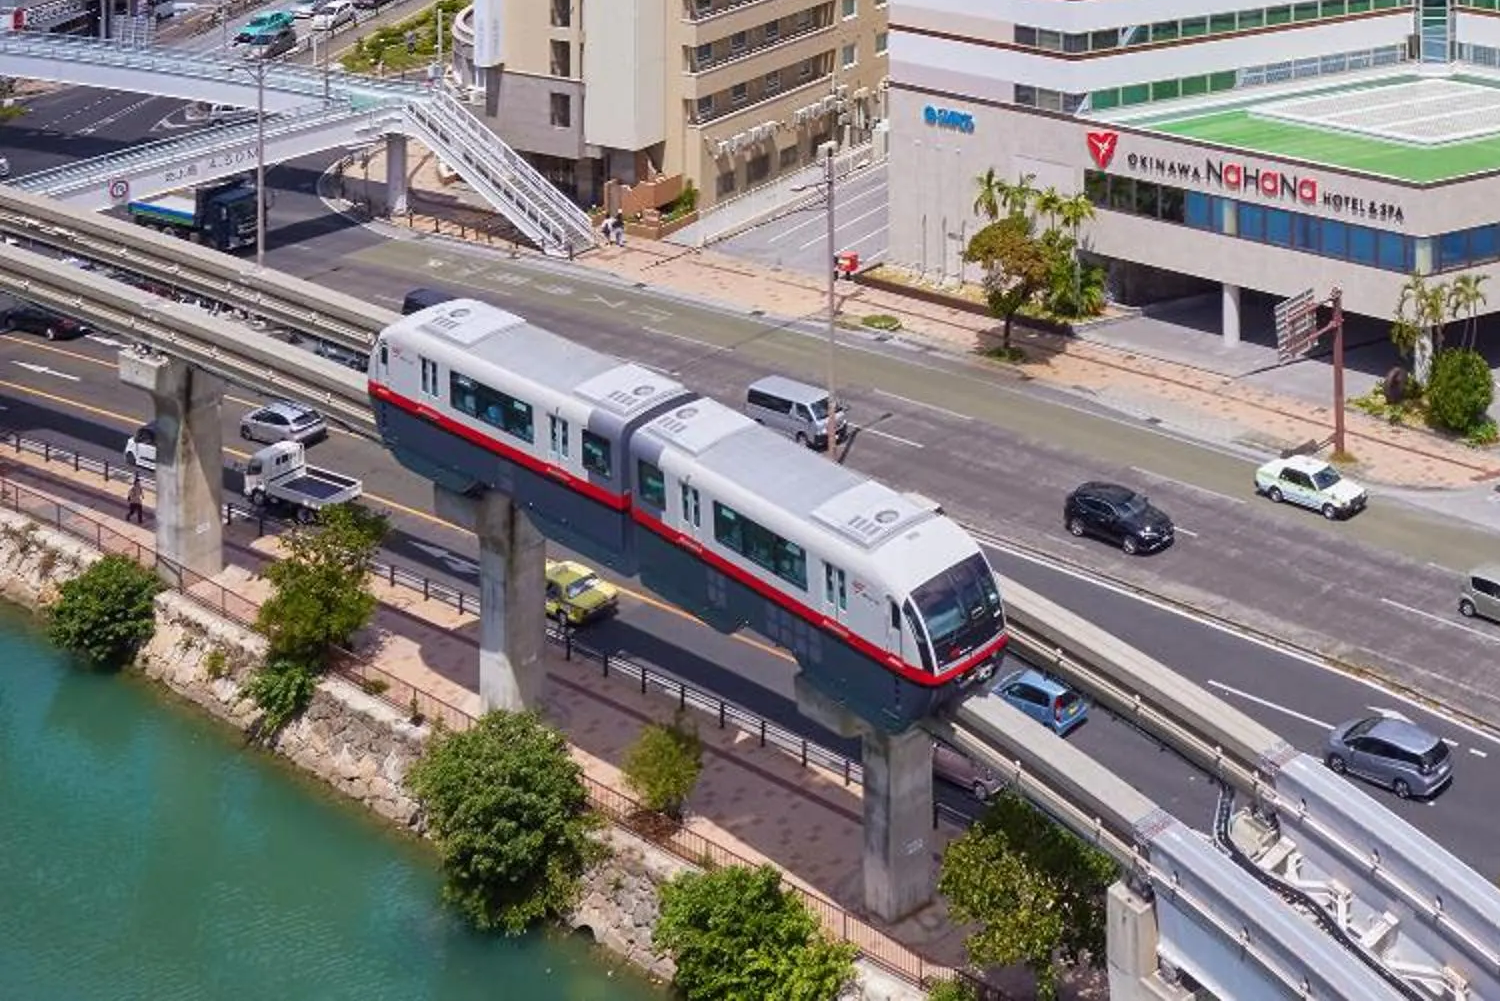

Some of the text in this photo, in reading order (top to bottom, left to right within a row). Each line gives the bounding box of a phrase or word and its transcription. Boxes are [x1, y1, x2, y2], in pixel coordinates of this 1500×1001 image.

[1128, 153, 1201, 181] OKINAWA
[1322, 191, 1366, 213] HOTEL
[1379, 203, 1405, 222] SPA
